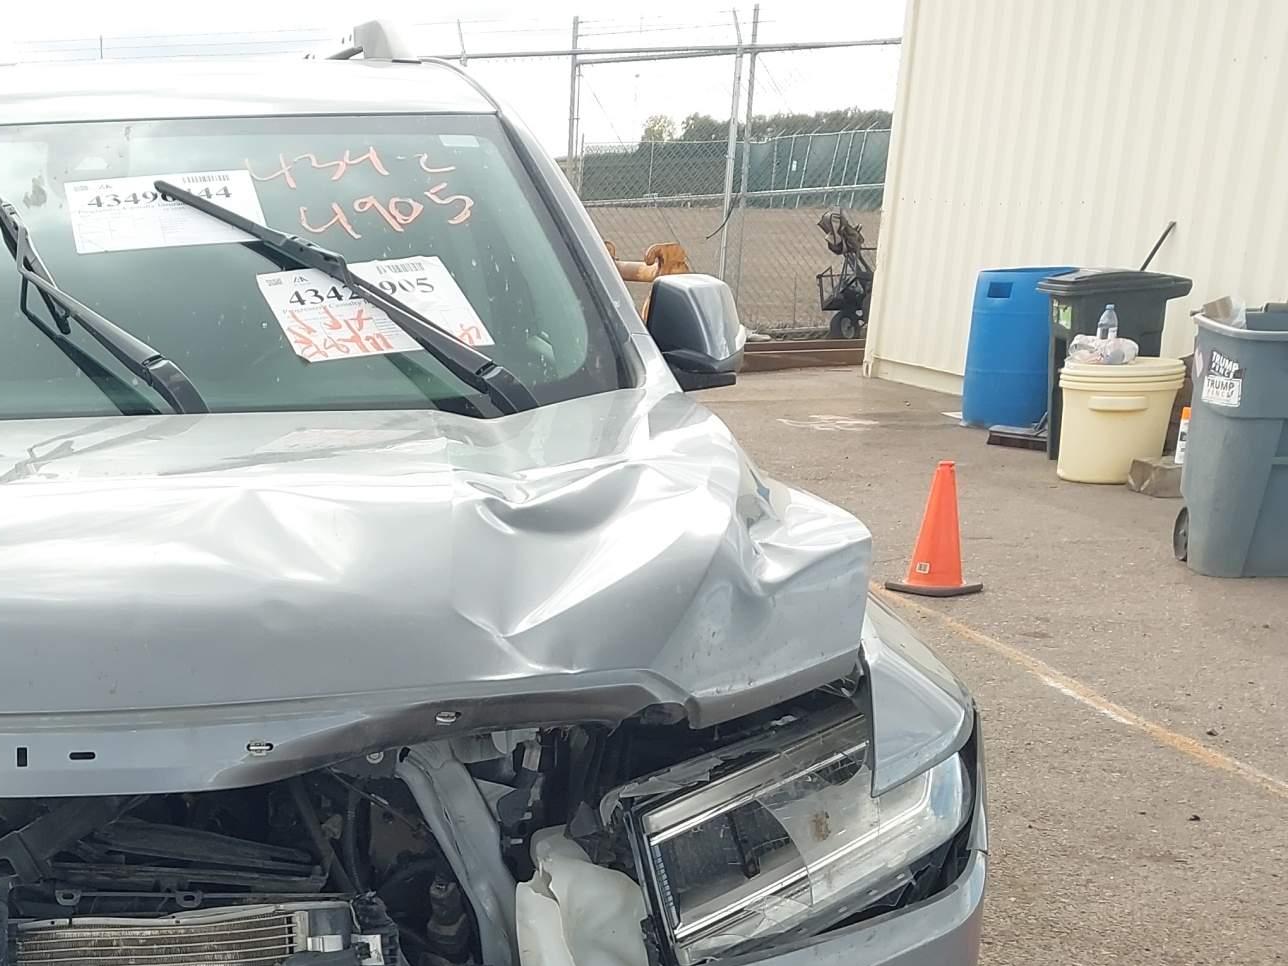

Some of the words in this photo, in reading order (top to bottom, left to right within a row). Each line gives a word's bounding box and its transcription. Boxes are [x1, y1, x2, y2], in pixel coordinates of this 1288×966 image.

[88, 186, 232, 208] 4349644
[299, 183, 474, 239] 4905
[1211, 351, 1240, 372] TRUMP
[1207, 379, 1235, 391] TRUMP
